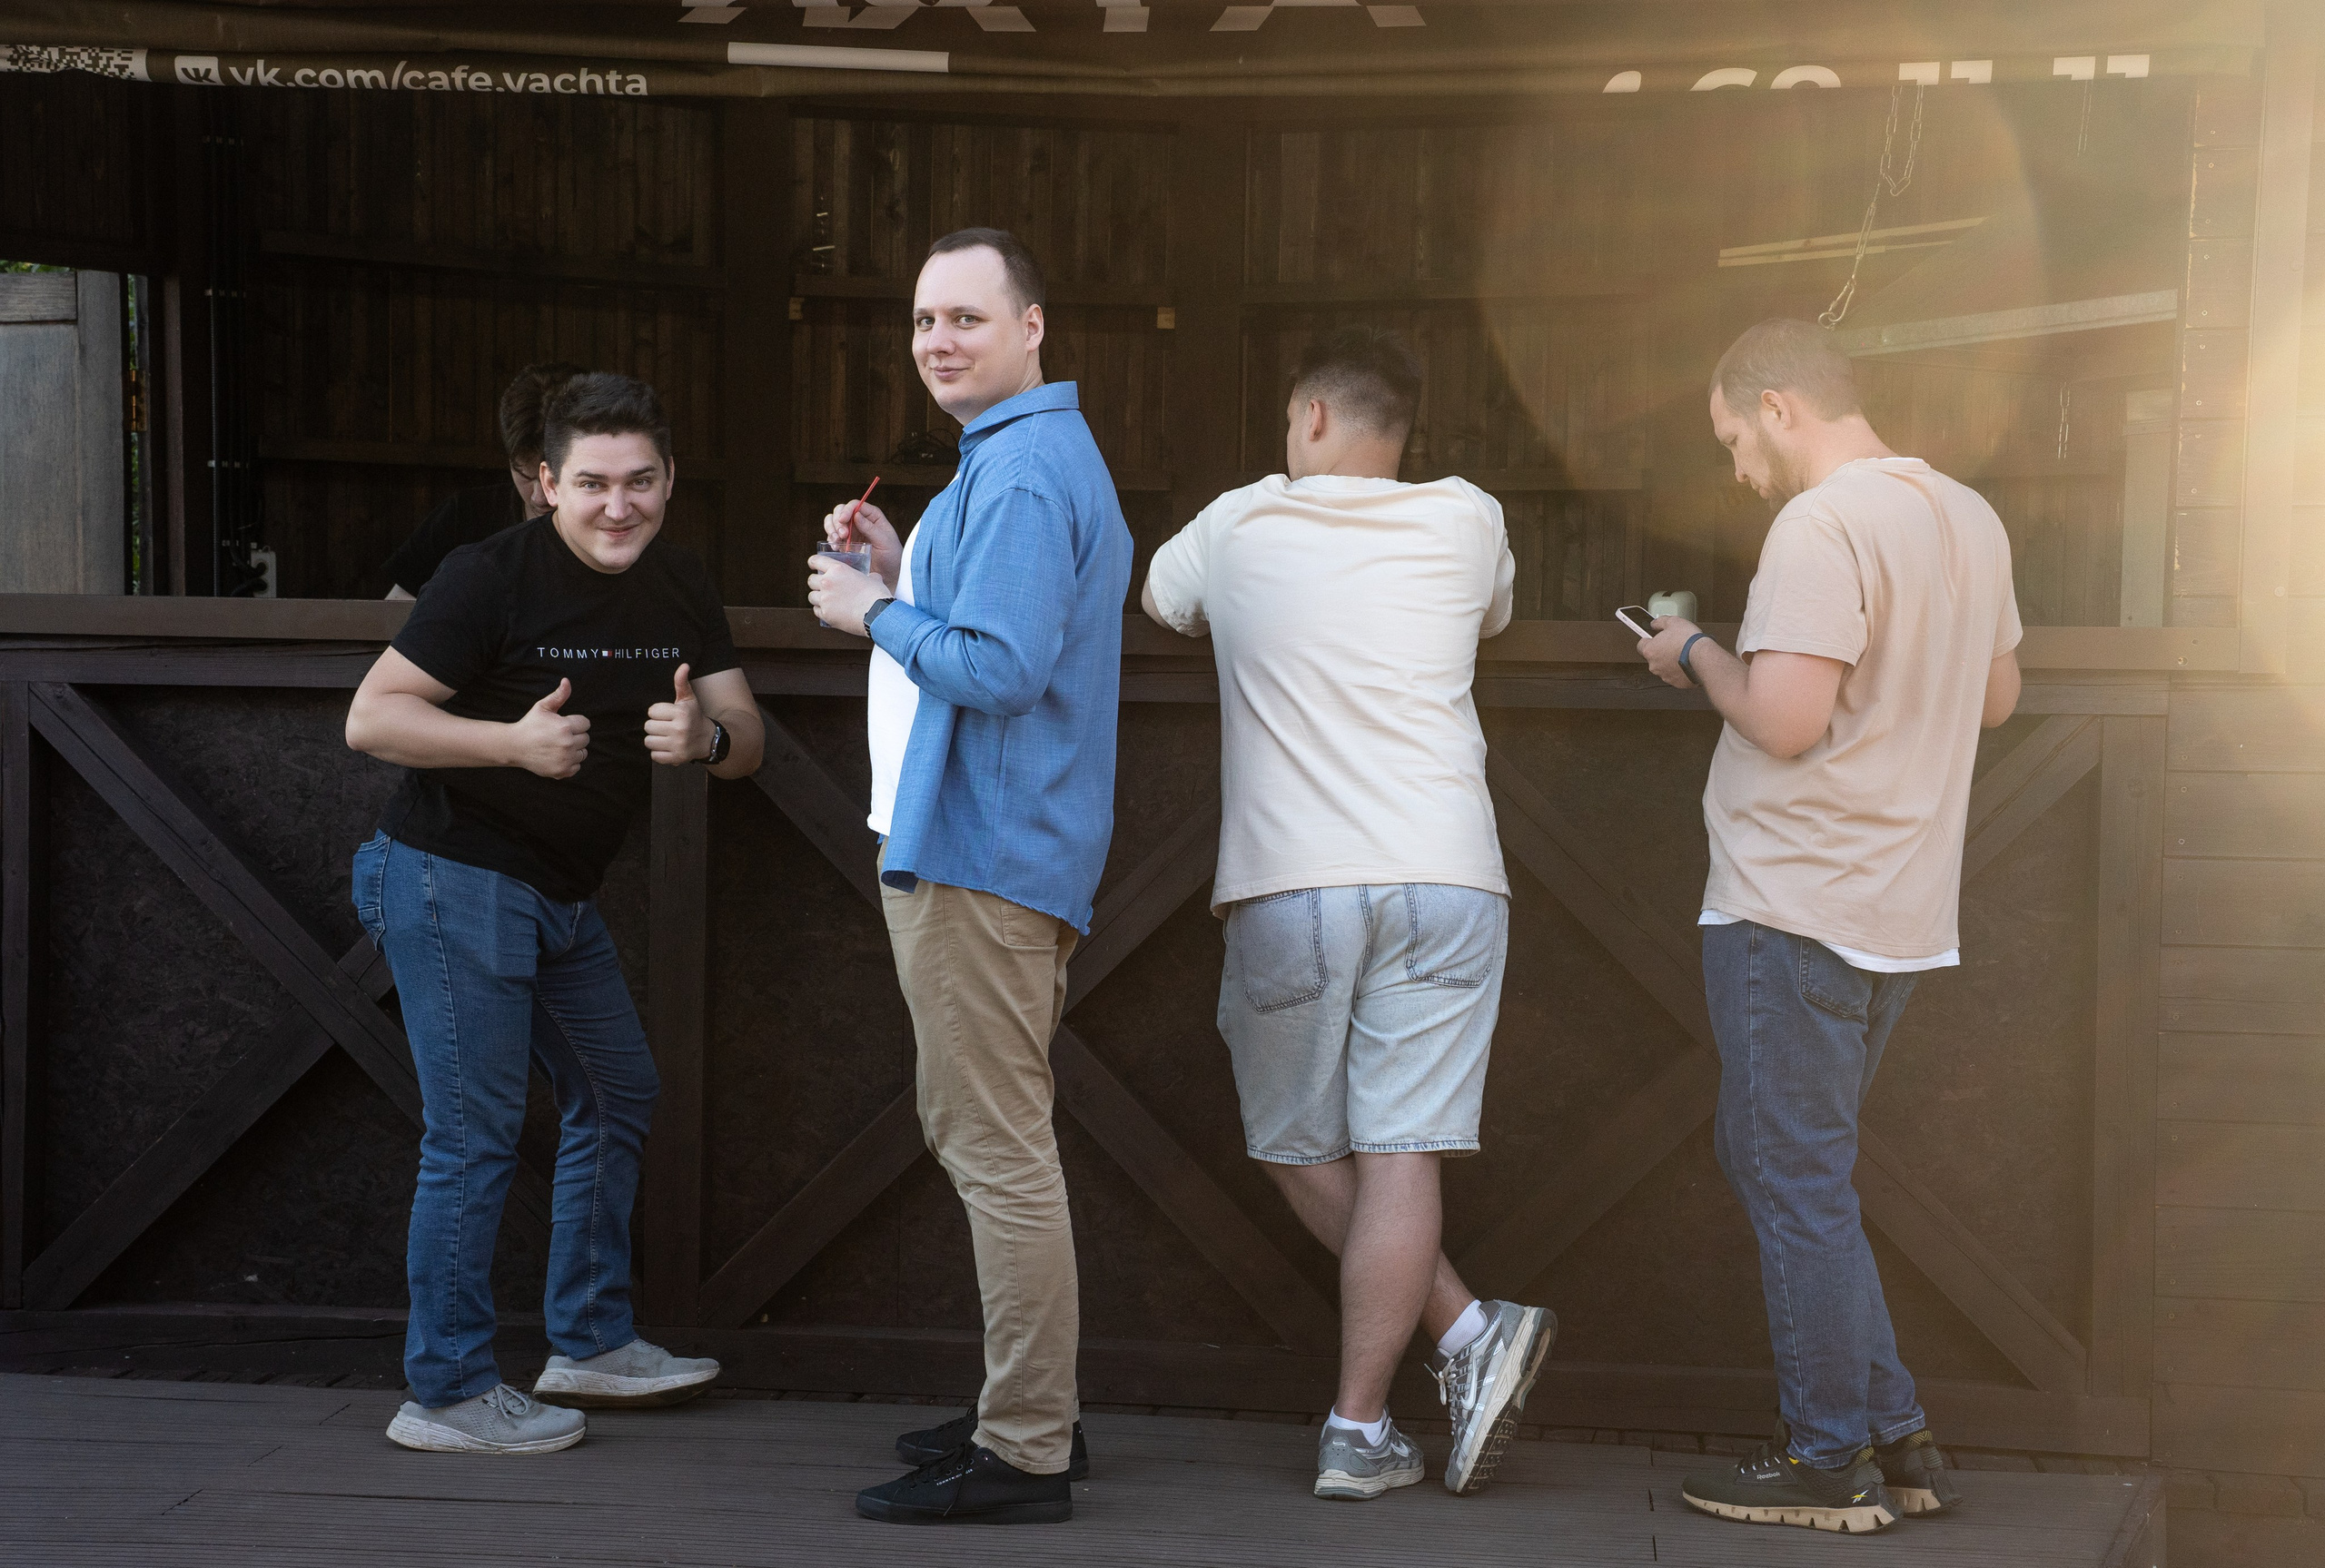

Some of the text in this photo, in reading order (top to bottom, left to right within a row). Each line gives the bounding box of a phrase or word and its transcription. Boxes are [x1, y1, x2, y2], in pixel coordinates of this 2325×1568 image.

[229, 59, 648, 95] vk.com/cafe.vachta
[537, 647, 679, 659] TOMMY HILFIGER
[1756, 1471, 1781, 1480] Reebok
